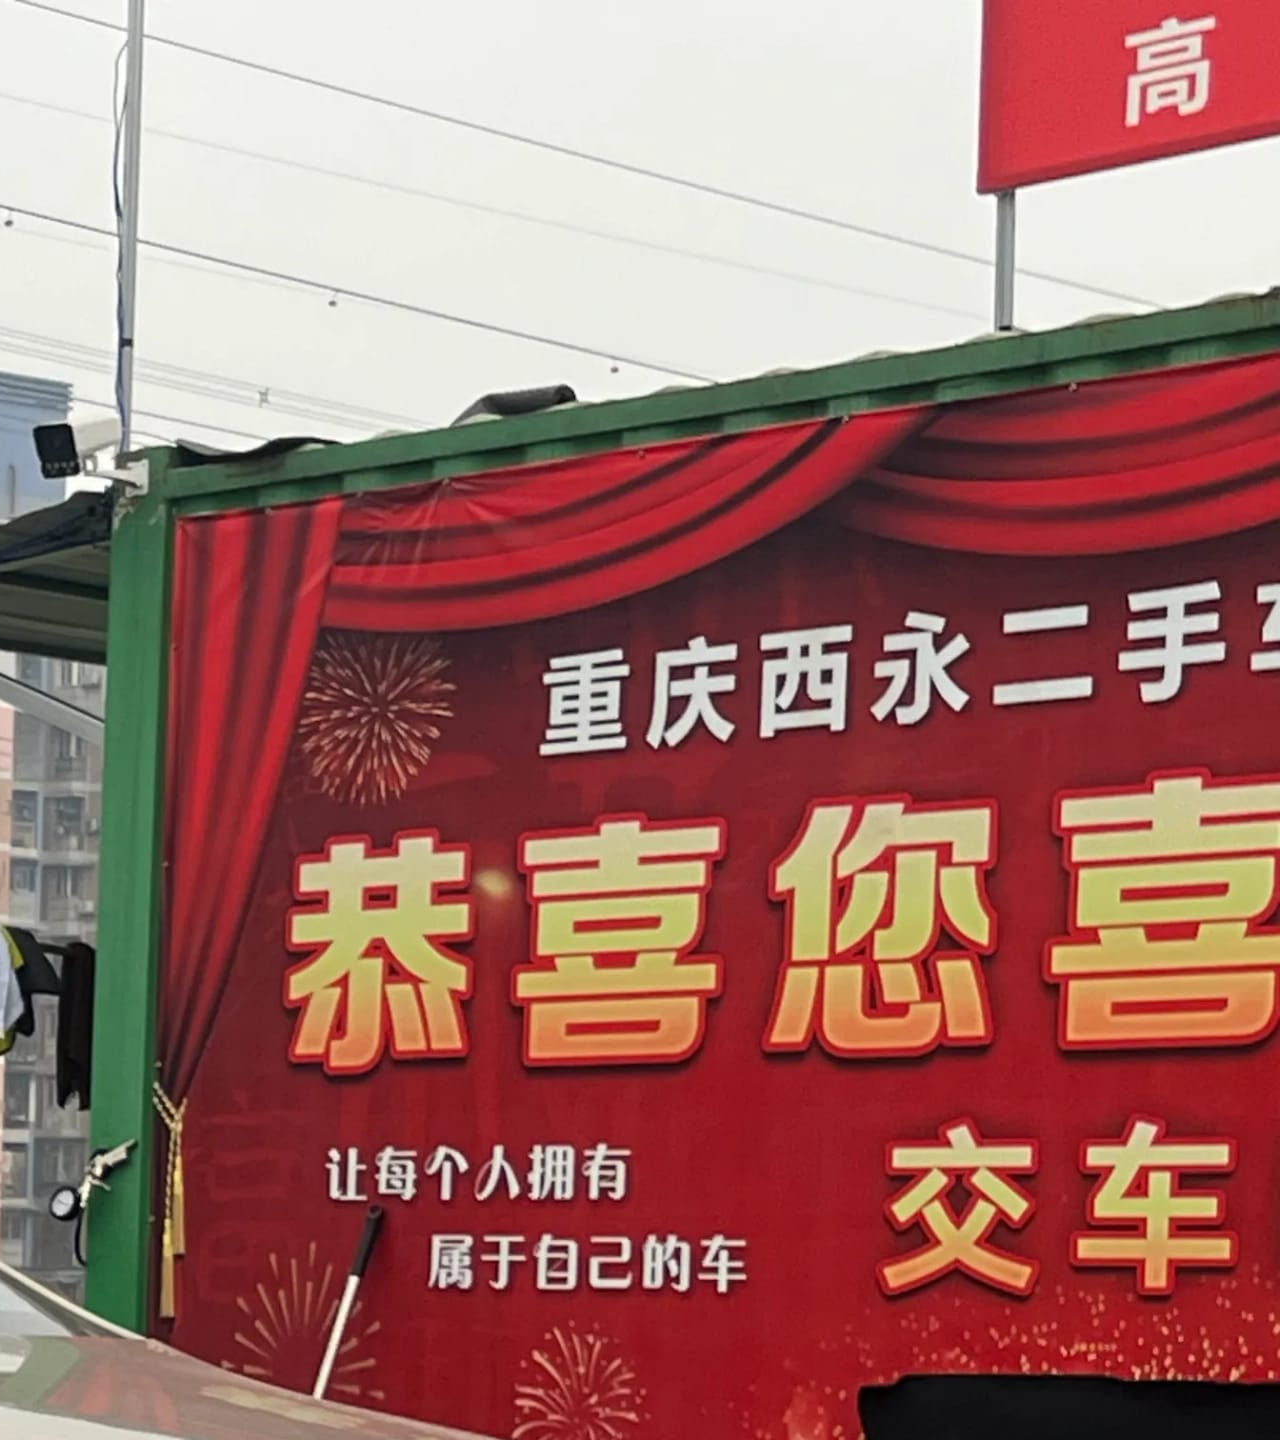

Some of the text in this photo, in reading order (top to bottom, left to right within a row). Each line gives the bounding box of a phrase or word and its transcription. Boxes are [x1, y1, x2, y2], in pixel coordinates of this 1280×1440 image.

[1124, 15, 1216, 127] 高
[285, 773, 1280, 1067] 恭喜您喜
[325, 1143, 632, 1202] 让每个人拥有
[883, 1118, 1236, 1294] 交车
[428, 1233, 748, 1293] 属于自己的车
